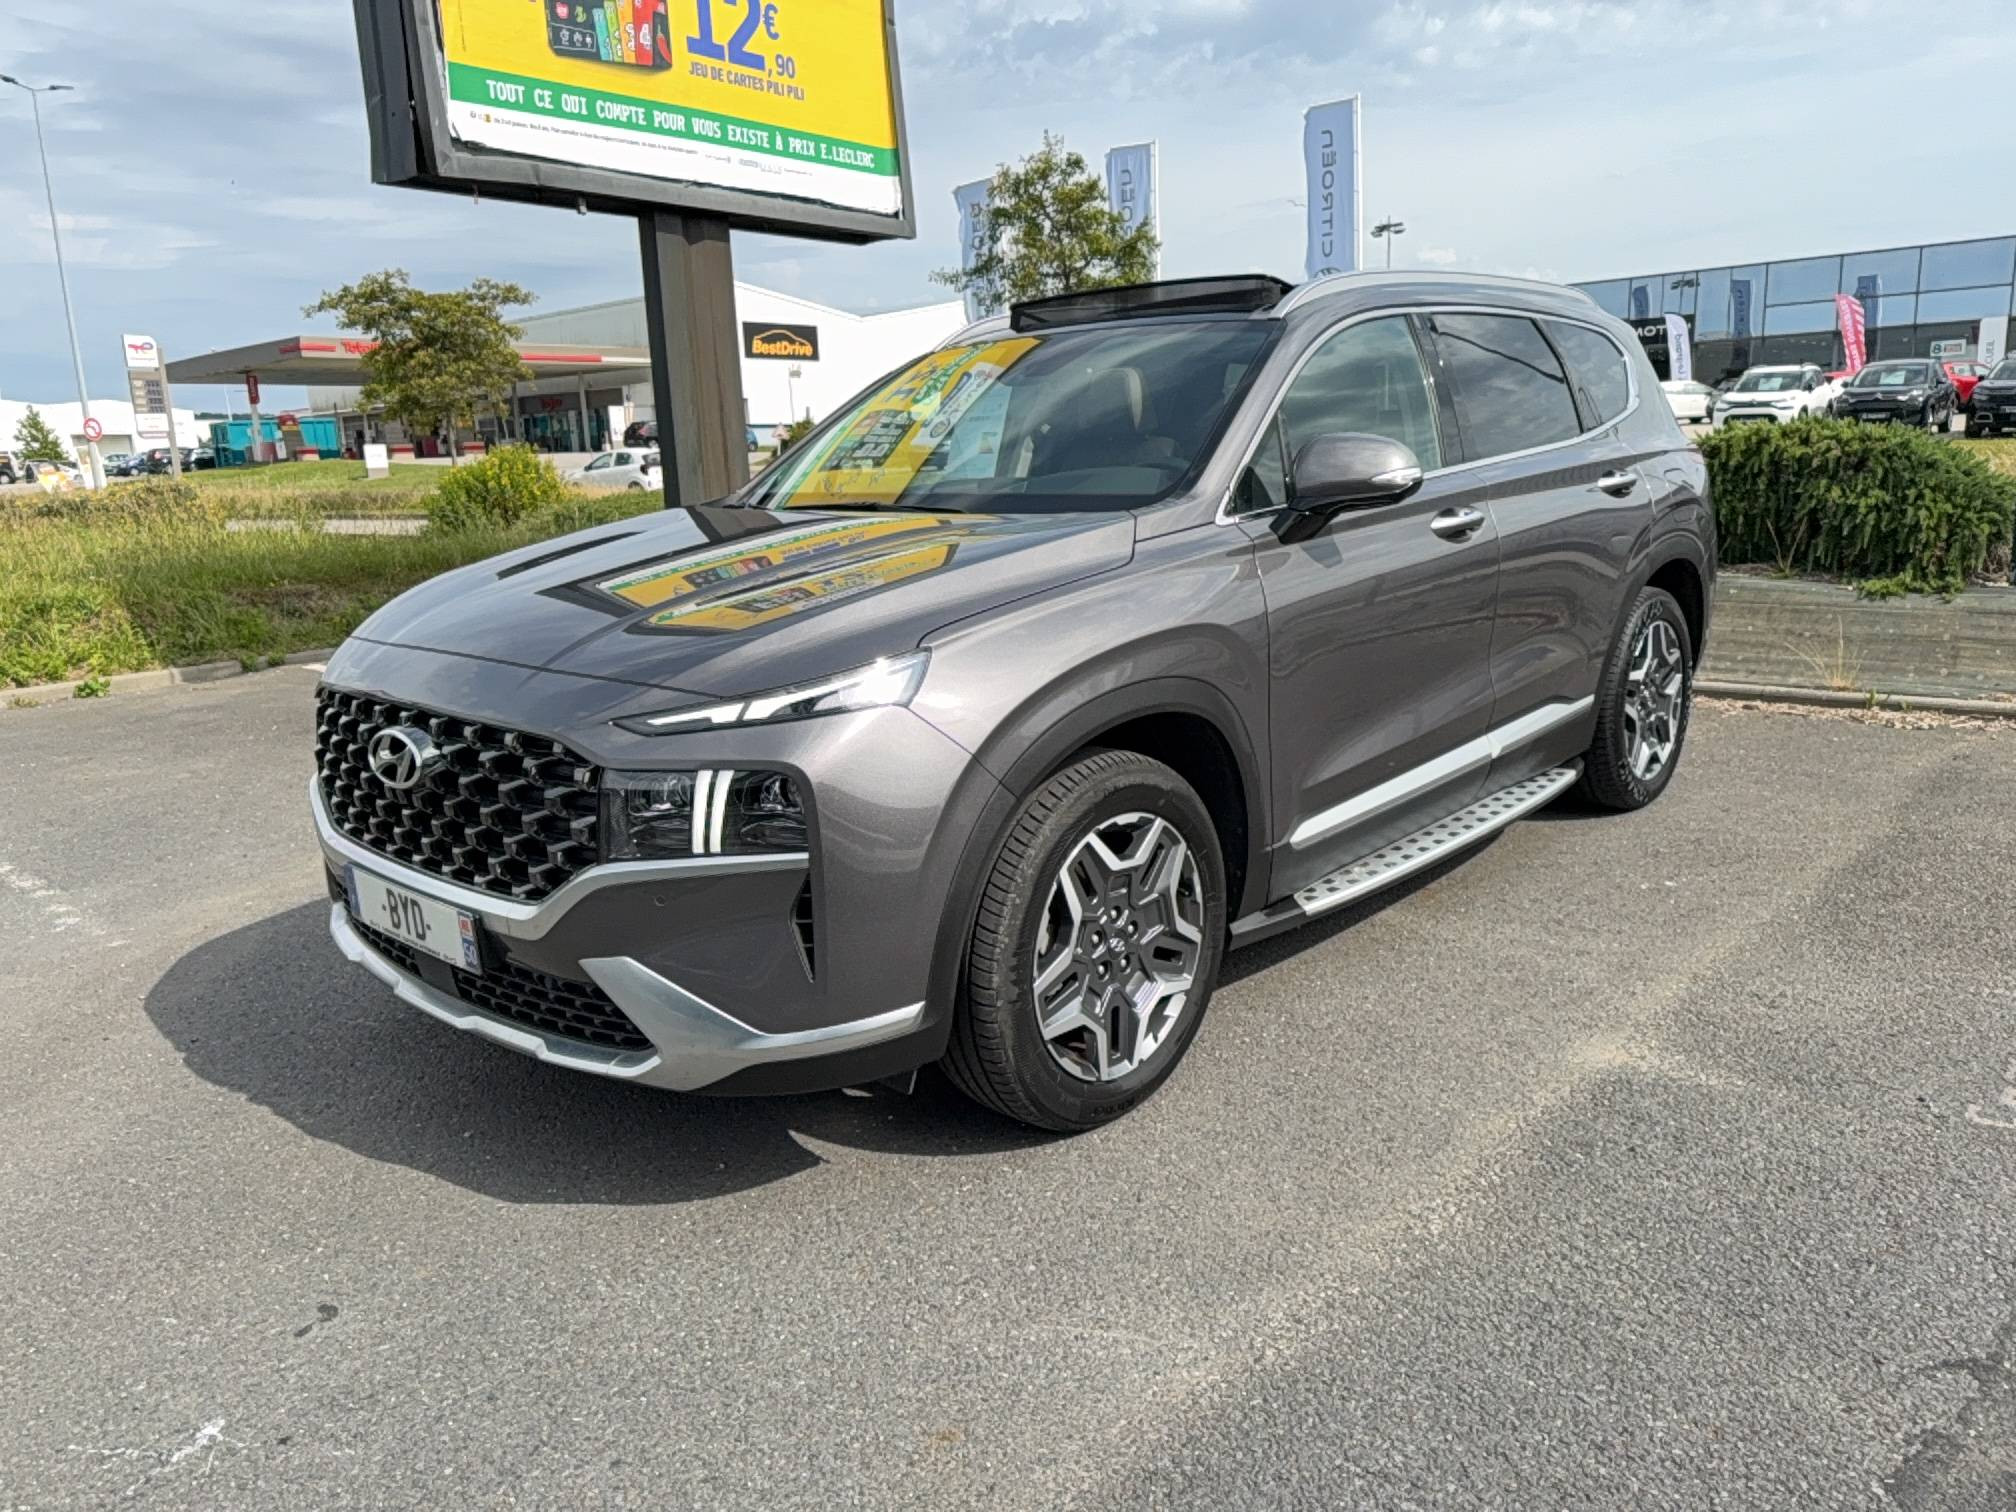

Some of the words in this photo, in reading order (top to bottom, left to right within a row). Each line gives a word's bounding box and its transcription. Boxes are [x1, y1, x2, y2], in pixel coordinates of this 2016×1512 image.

[689, 61, 708, 78] JEU
[710, 67, 724, 83] DE
[726, 70, 765, 93] CARTES
[766, 79, 785, 97] PILI
[787, 83, 805, 101] PILI
[486, 79, 525, 105] TOUT
[533, 88, 554, 109] CE
[561, 93, 588, 116] QUI
[595, 99, 647, 126] COMPTE
[653, 110, 686, 132] POUR
[691, 116, 722, 139] VOUS
[727, 124, 770, 148] EXISTE
[775, 130, 784, 151] À
[788, 136, 816, 157] PRIX
[820, 143, 876, 169] E.LECLERC
[751, 339, 813, 357] BestDrive
